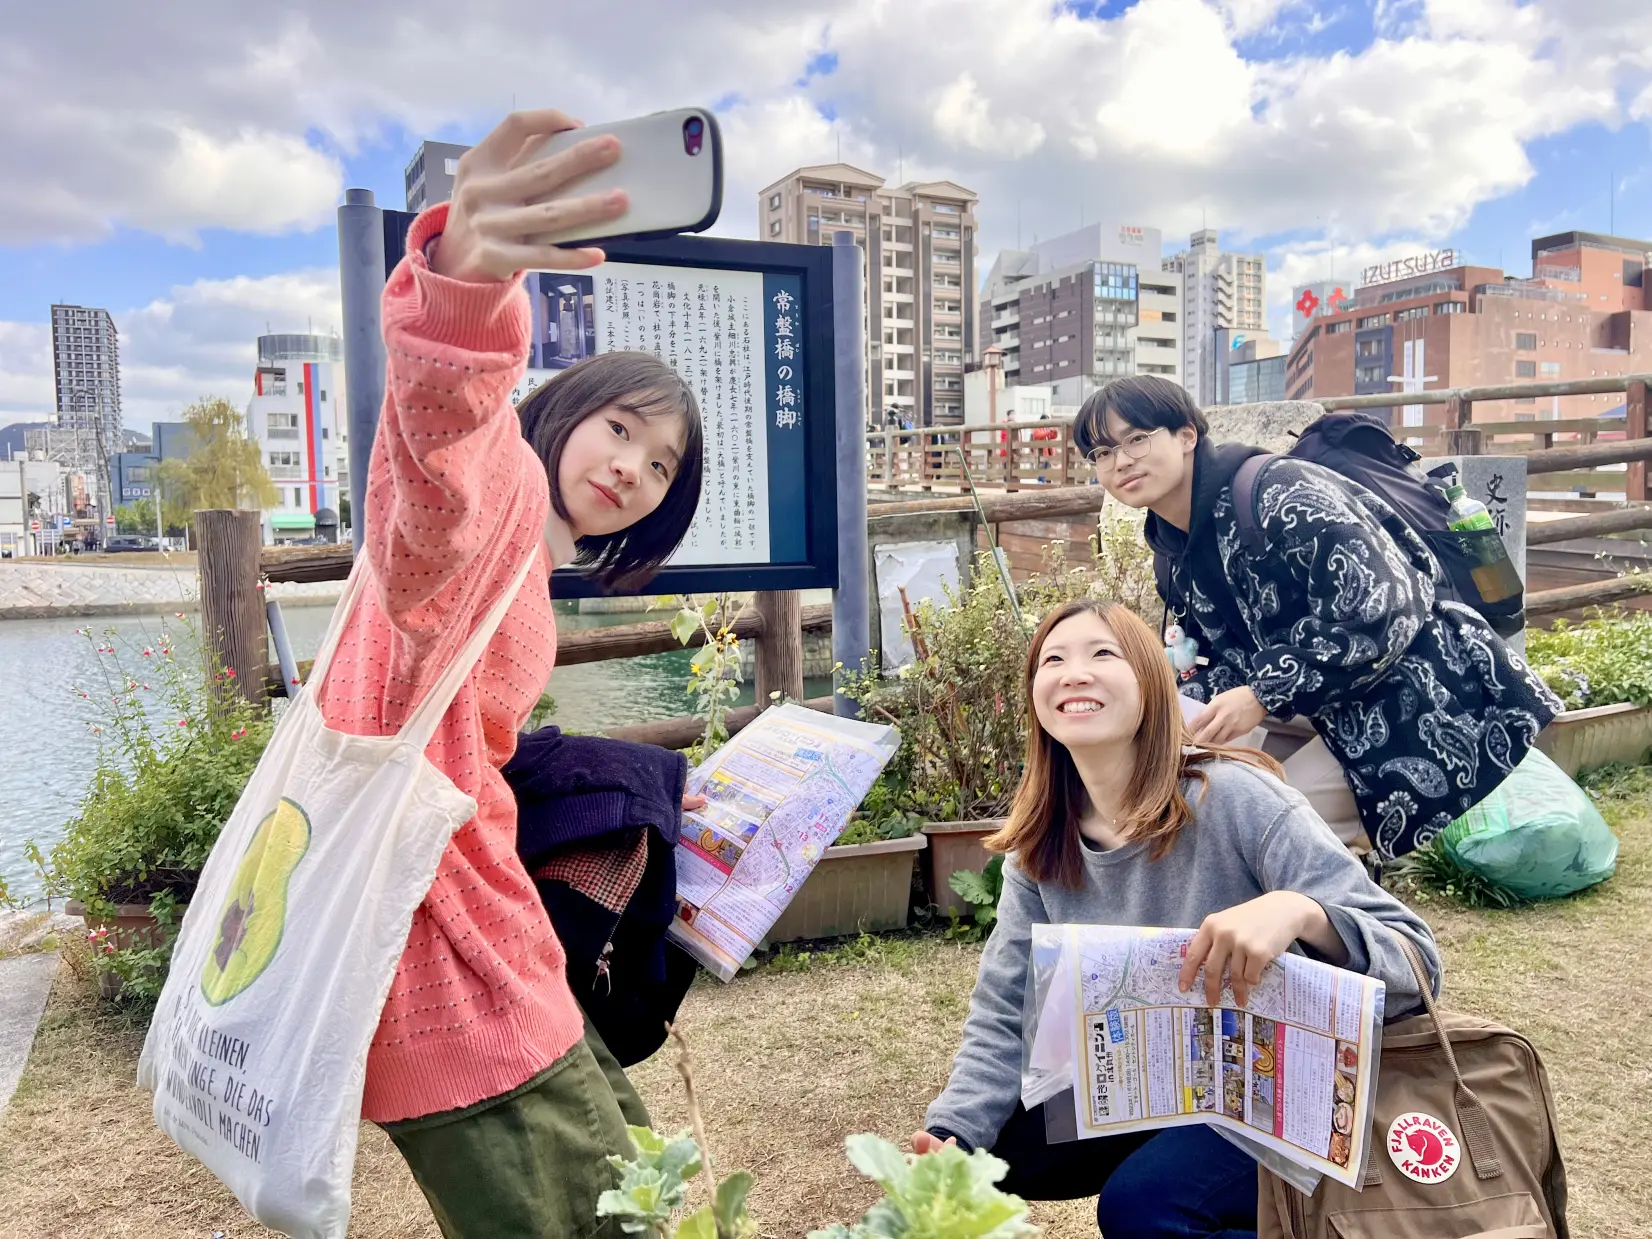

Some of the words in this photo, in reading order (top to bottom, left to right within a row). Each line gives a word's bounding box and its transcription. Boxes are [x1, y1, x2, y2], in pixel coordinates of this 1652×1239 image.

[773, 289, 797, 430] 常盤橋の橋脚
[198, 1022, 250, 1075] KLEINEN,
[1108, 1010, 1123, 1042] 体験版
[187, 1057, 217, 1101] INGE,
[224, 1075, 247, 1112] DIE
[247, 1088, 274, 1127] DAS
[219, 1109, 262, 1164] MACHEN.
